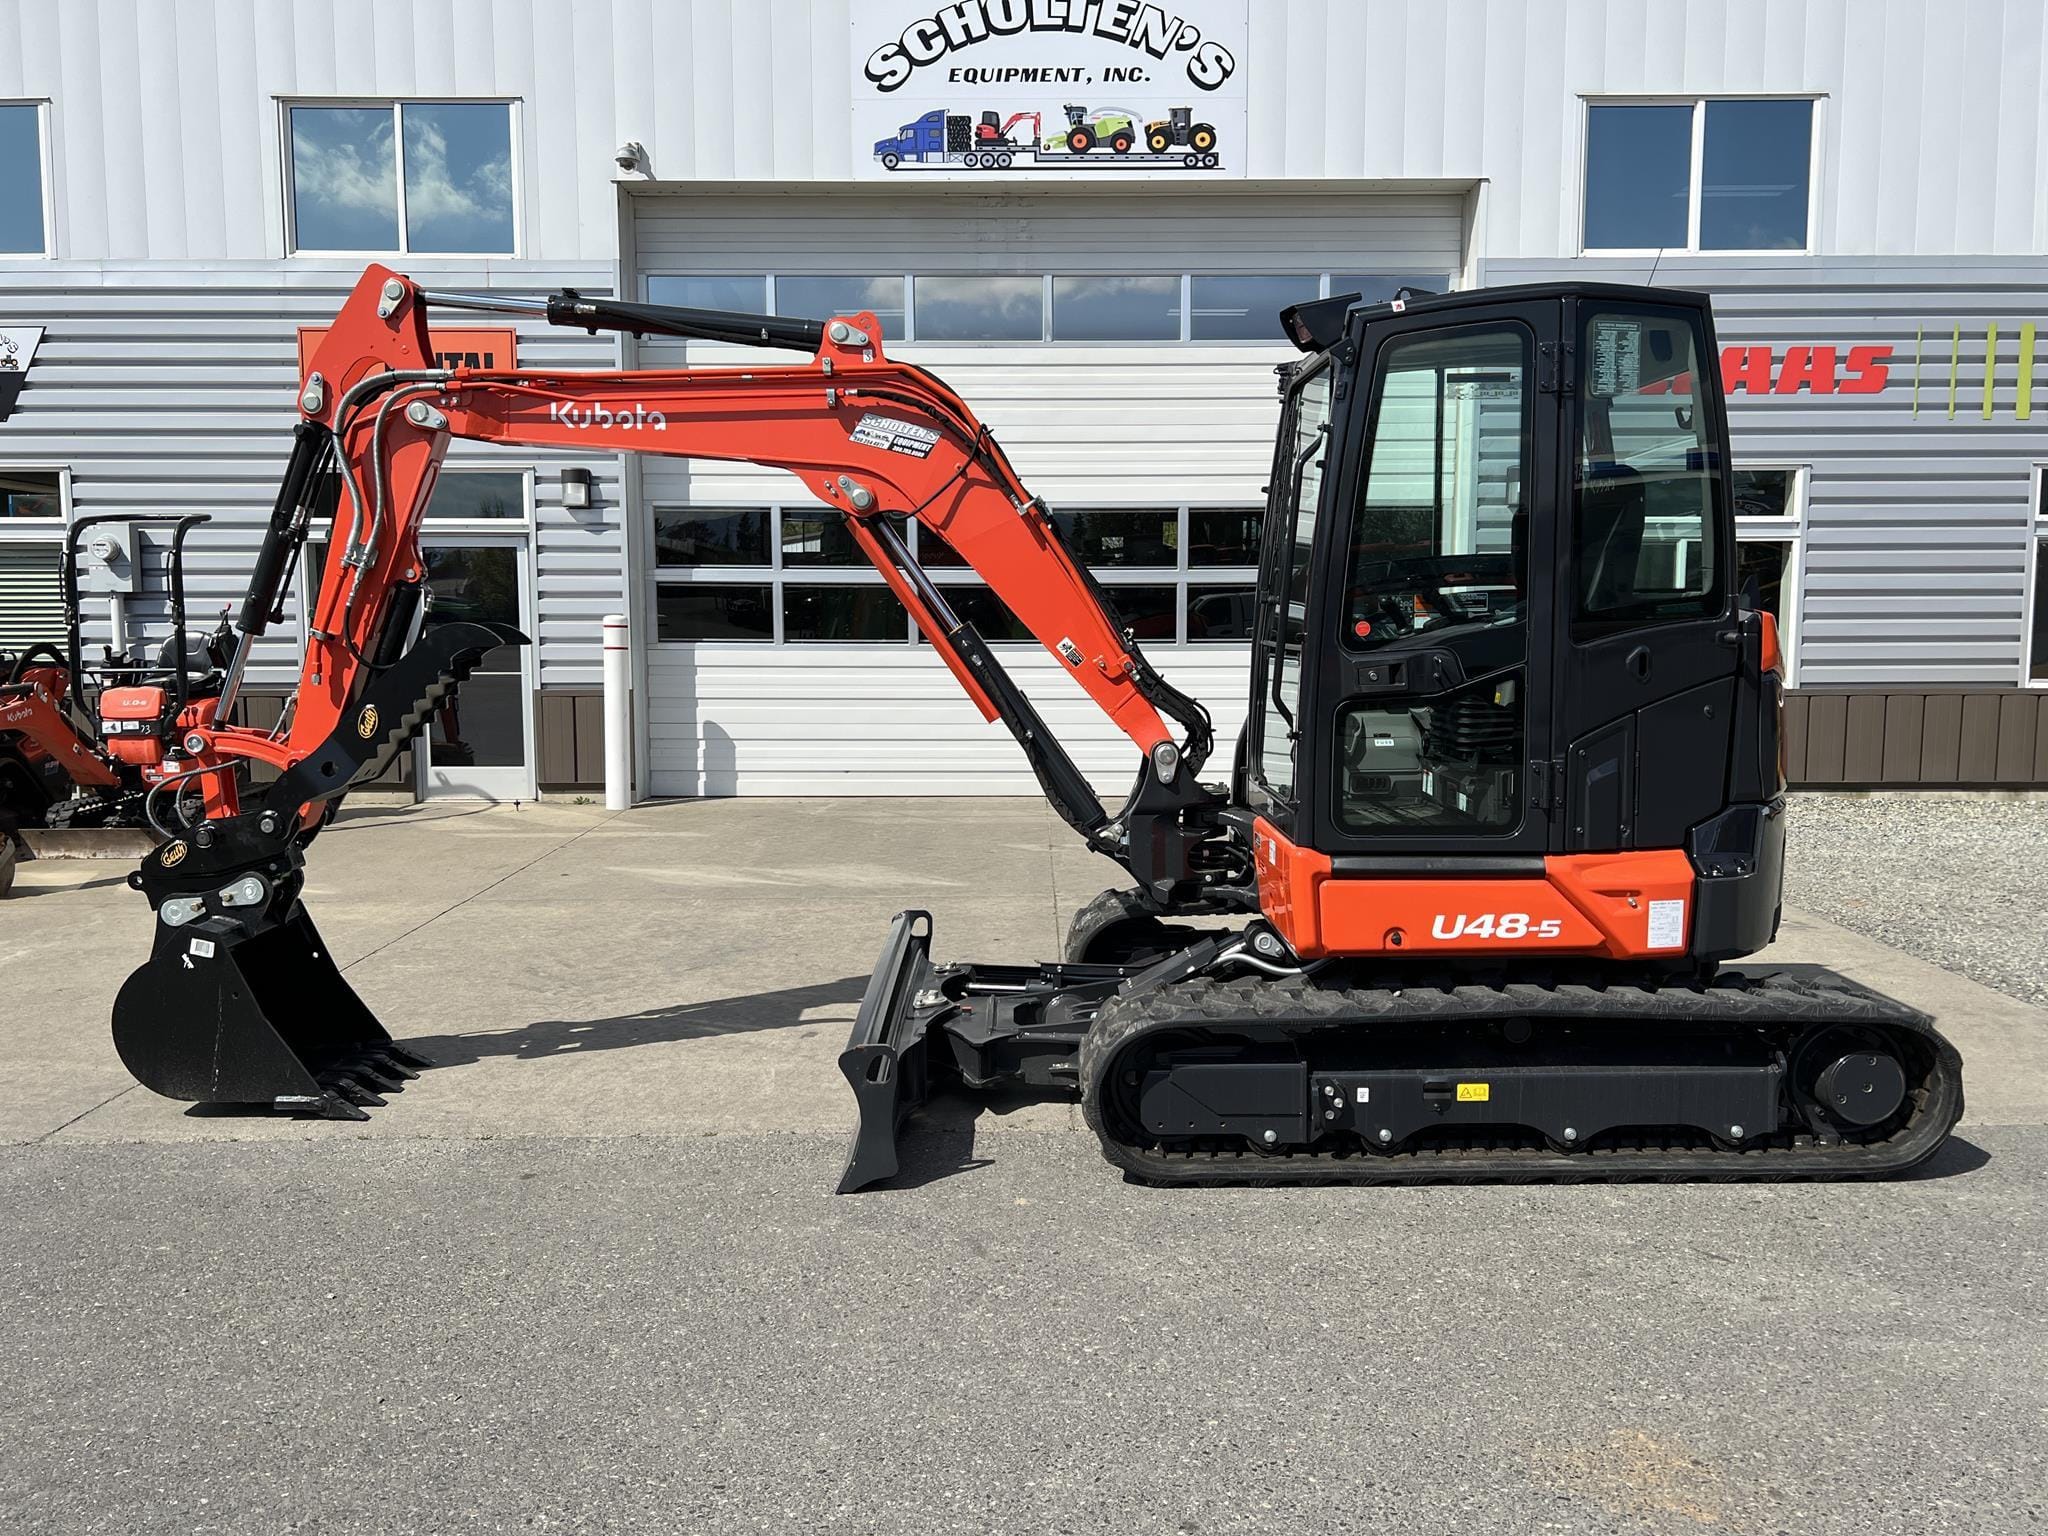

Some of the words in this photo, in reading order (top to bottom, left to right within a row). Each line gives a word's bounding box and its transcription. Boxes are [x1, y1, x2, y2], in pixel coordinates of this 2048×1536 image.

[864, 0, 1235, 92] SCHOLTEN'S
[948, 67, 1093, 86] EQUIPMENT,
[1102, 67, 1151, 83] INC.
[550, 401, 667, 431] Kubota
[861, 415, 940, 442] SCHOLTEN'S
[893, 436, 933, 452] EQUIPMENT
[7, 707, 33, 722] Kubota
[1431, 913, 1562, 940] U48-5
